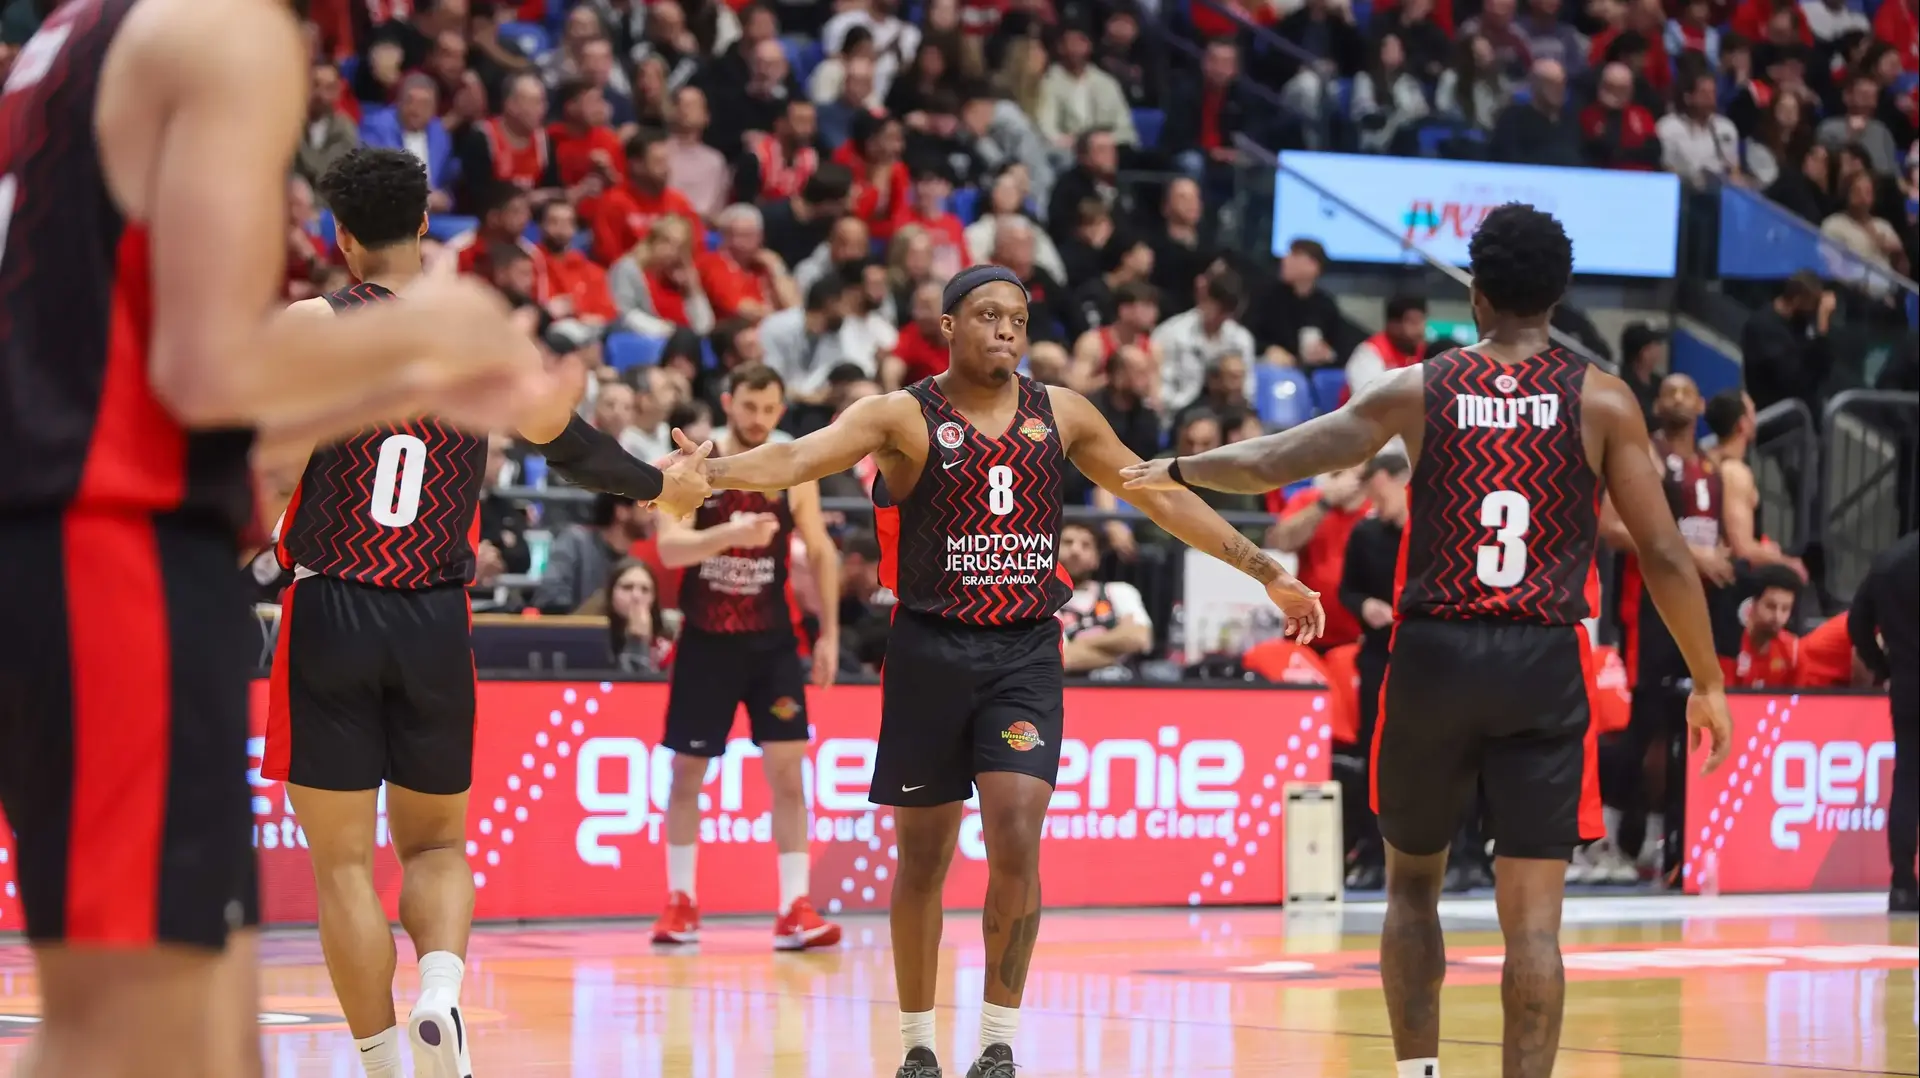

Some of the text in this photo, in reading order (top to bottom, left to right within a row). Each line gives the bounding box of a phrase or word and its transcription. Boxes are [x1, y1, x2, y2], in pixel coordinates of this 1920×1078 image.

[371, 434, 427, 528] 0
[988, 465, 1014, 516] 8
[947, 534, 1053, 552] MIDTOWN
[1476, 490, 1530, 588] 3
[945, 553, 1053, 571] JERUSALEM
[648, 811, 773, 843] Tsted
[807, 810, 876, 842] loud
[1040, 808, 1138, 840] rusted
[1145, 808, 1235, 839] Cloud
